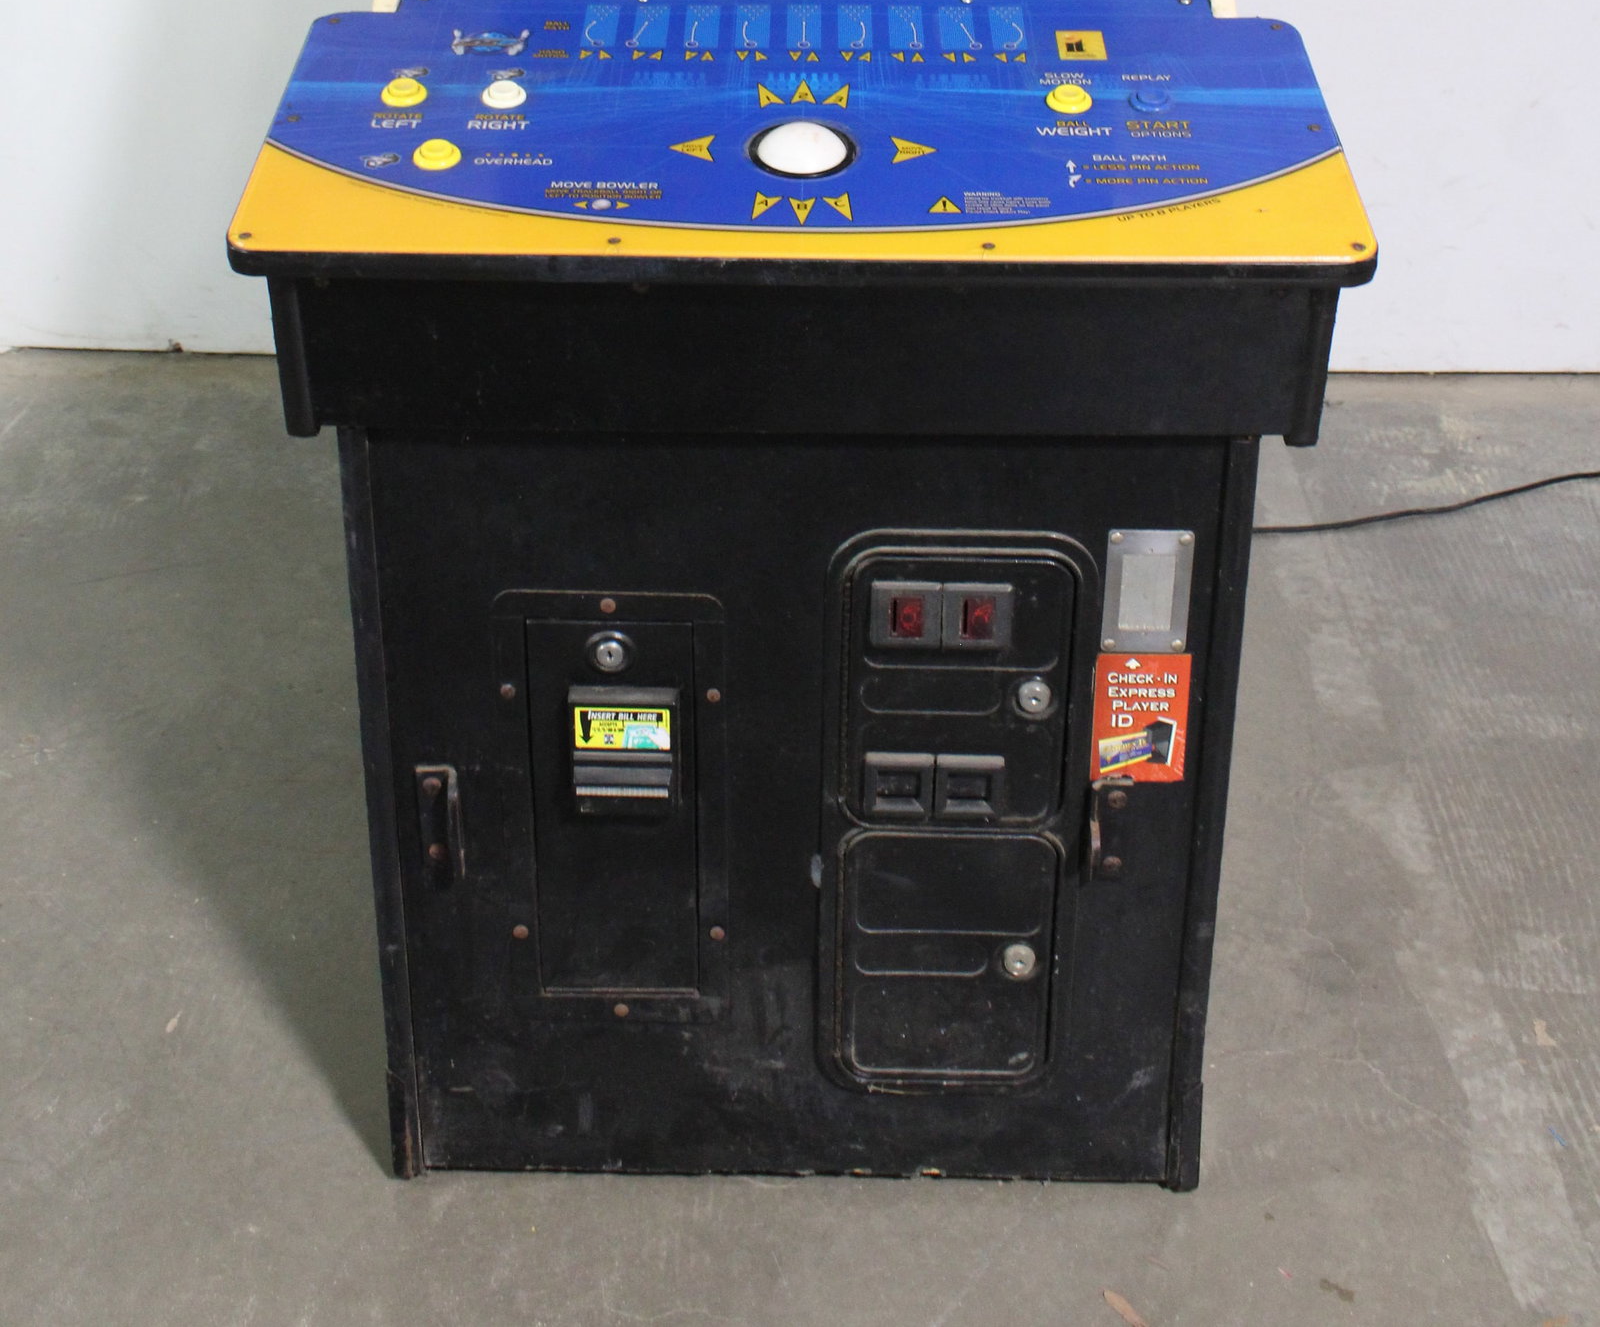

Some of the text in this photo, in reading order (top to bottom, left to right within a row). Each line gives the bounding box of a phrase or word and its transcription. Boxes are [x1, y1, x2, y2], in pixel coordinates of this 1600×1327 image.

[1121, 74, 1171, 82] REPLAY
[371, 119, 422, 129] LEFT
[467, 120, 530, 130] RIGHT
[1126, 120, 1191, 130] START
[1036, 127, 1113, 137] WEIGHT
[1131, 130, 1192, 138] OPTIONS
[474, 157, 553, 166] OVERHEAD
[1092, 154, 1167, 162] BALL PATH
[1093, 163, 1126, 171] LESS
[551, 181, 659, 190] MOVE BOWLER
[1096, 177, 1133, 185] MORE
[1117, 214, 1135, 223] UP
[1139, 211, 1155, 219] TO
[1169, 198, 1222, 214] PLAYERS
[1107, 672, 1178, 685] CHECK IN
[1107, 686, 1176, 699] EXPRESS
[1112, 699, 1170, 712] PLAYER
[588, 709, 658, 722] INSERT BILL HERE
[1111, 714, 1134, 728] ID
